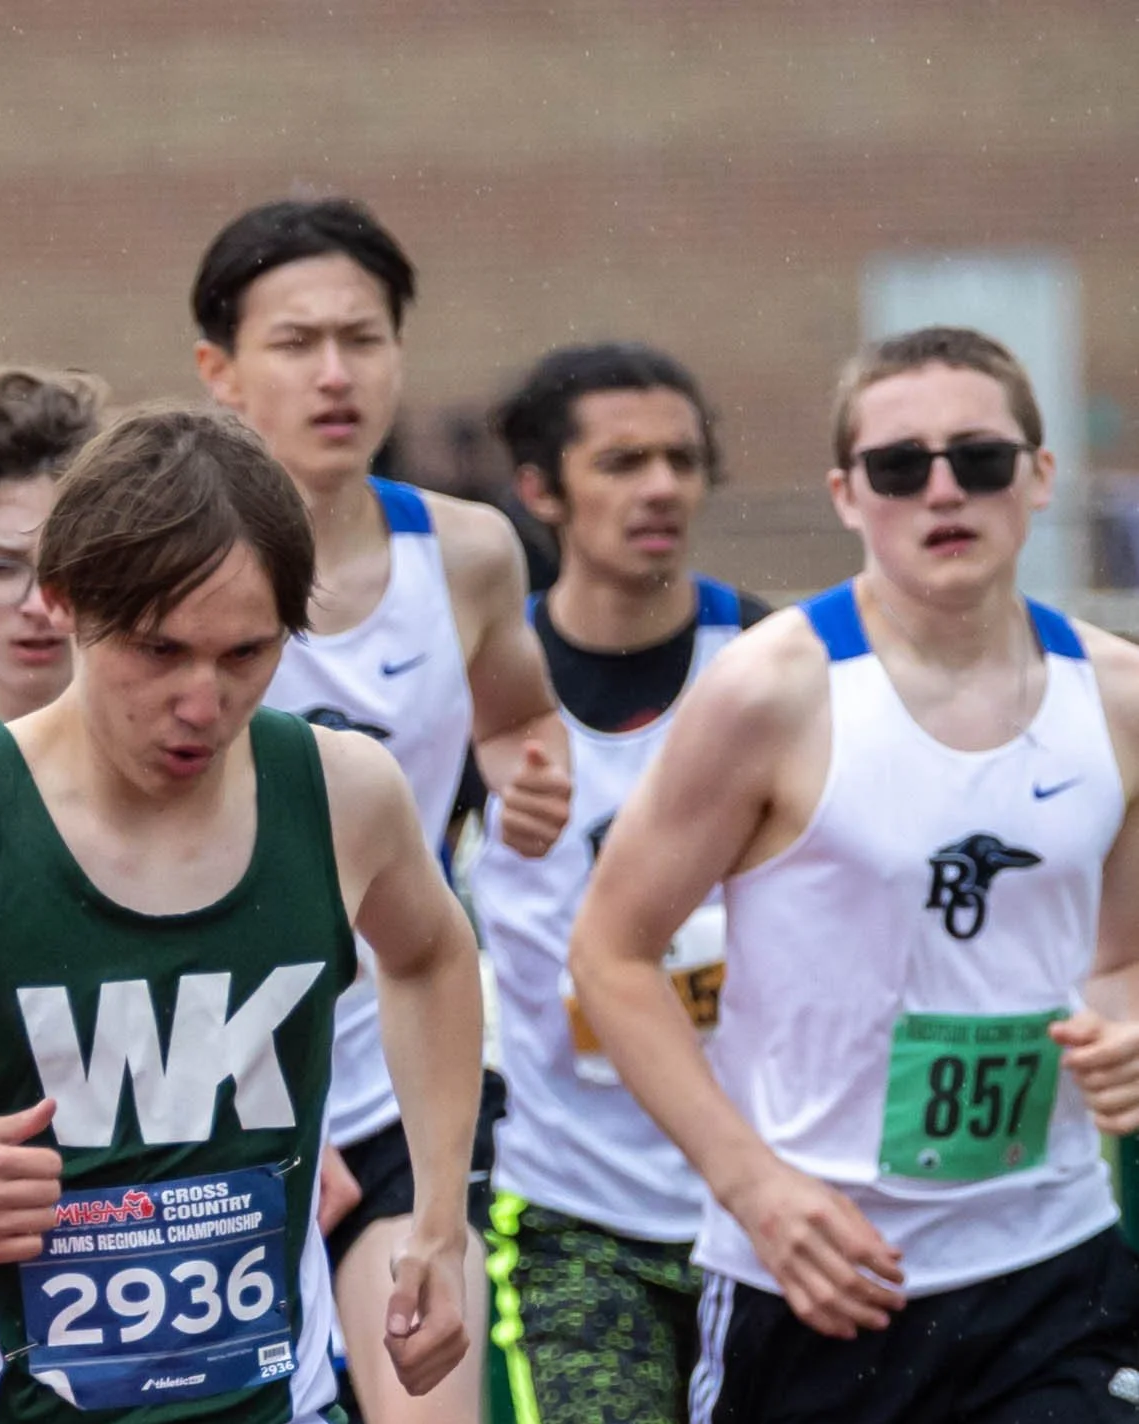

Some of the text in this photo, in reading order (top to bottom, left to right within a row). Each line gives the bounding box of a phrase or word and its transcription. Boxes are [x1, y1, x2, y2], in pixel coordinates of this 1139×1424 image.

[17, 961, 326, 1147] WK
[924, 1052, 1041, 1138] 857
[161, 1182, 229, 1205] CROSS
[163, 1193, 252, 1221] COUNTRY
[49, 1235, 95, 1255] JH/MS
[97, 1228, 165, 1250] REGIONAL
[167, 1211, 262, 1243] CHAMPIONSHIP
[41, 1245, 275, 1347] 2936
[260, 1360, 295, 1378] 2936
